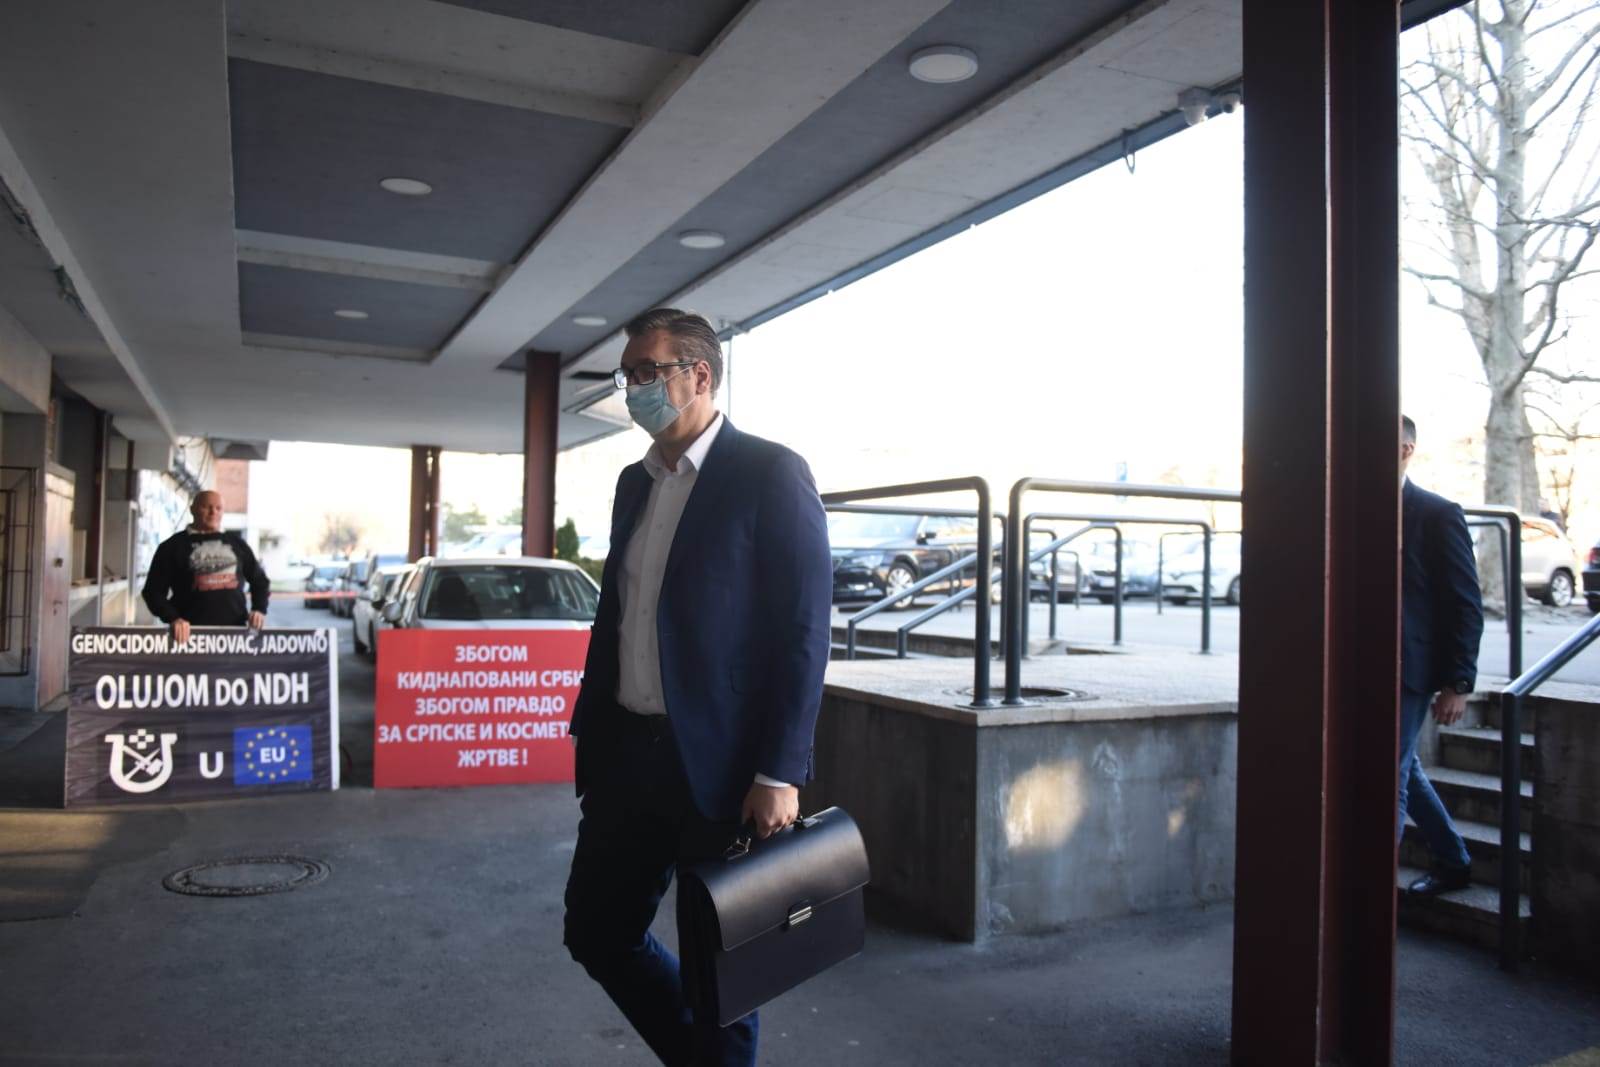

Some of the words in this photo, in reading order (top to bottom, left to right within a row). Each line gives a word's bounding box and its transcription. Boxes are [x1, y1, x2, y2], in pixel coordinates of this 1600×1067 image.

[72, 634, 168, 654] GENOCIDOM
[260, 635, 328, 654] JADOVNO
[455, 646, 528, 663] ЗБОГОМ
[96, 674, 209, 709] OLUJOM
[254, 672, 309, 705] NDH
[397, 671, 537, 692] КИДНАПОВАНИ
[415, 698, 490, 715] ЗБОГОМ
[494, 696, 565, 716] ПРАВДО
[378, 726, 401, 743] ЗА
[406, 724, 476, 742] СРПСКЕ
[480, 723, 492, 740] И
[496, 721, 572, 739] КОСМЕТ
[199, 752, 224, 779] U
[260, 747, 286, 763] EU
[457, 749, 518, 767] ЖРТВЕ
